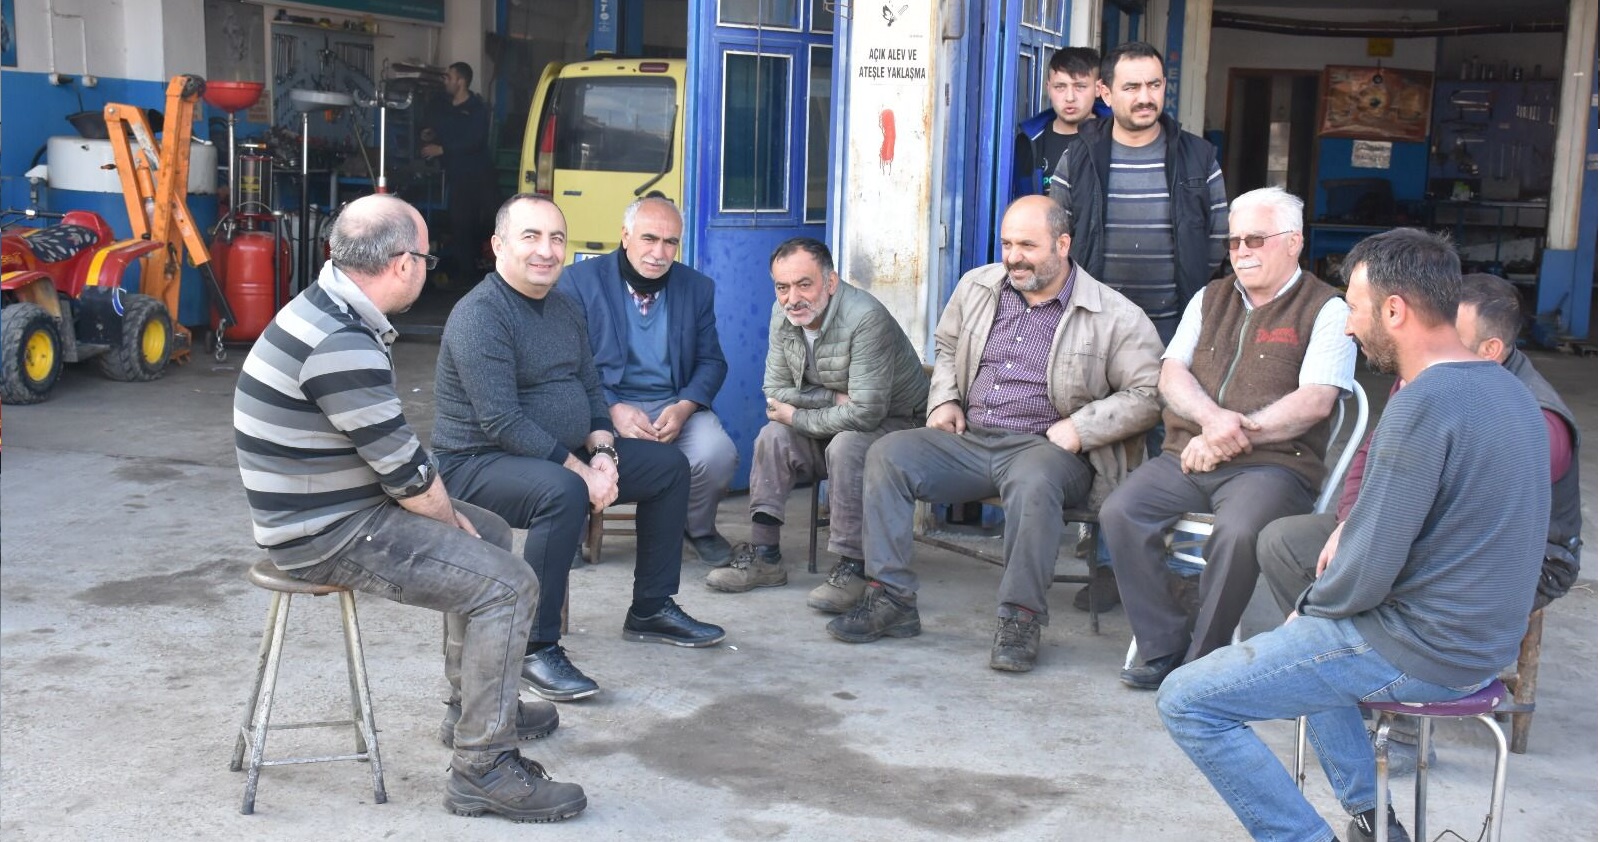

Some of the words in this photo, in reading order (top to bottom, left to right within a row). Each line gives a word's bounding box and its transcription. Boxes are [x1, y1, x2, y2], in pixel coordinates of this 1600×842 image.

[869, 48, 886, 62] AÇIK
[887, 48, 906, 61] ALEV
[908, 48, 917, 61] VE
[858, 66, 885, 80] ATEŞLE
[887, 66, 926, 81] YAKLAŞMA
